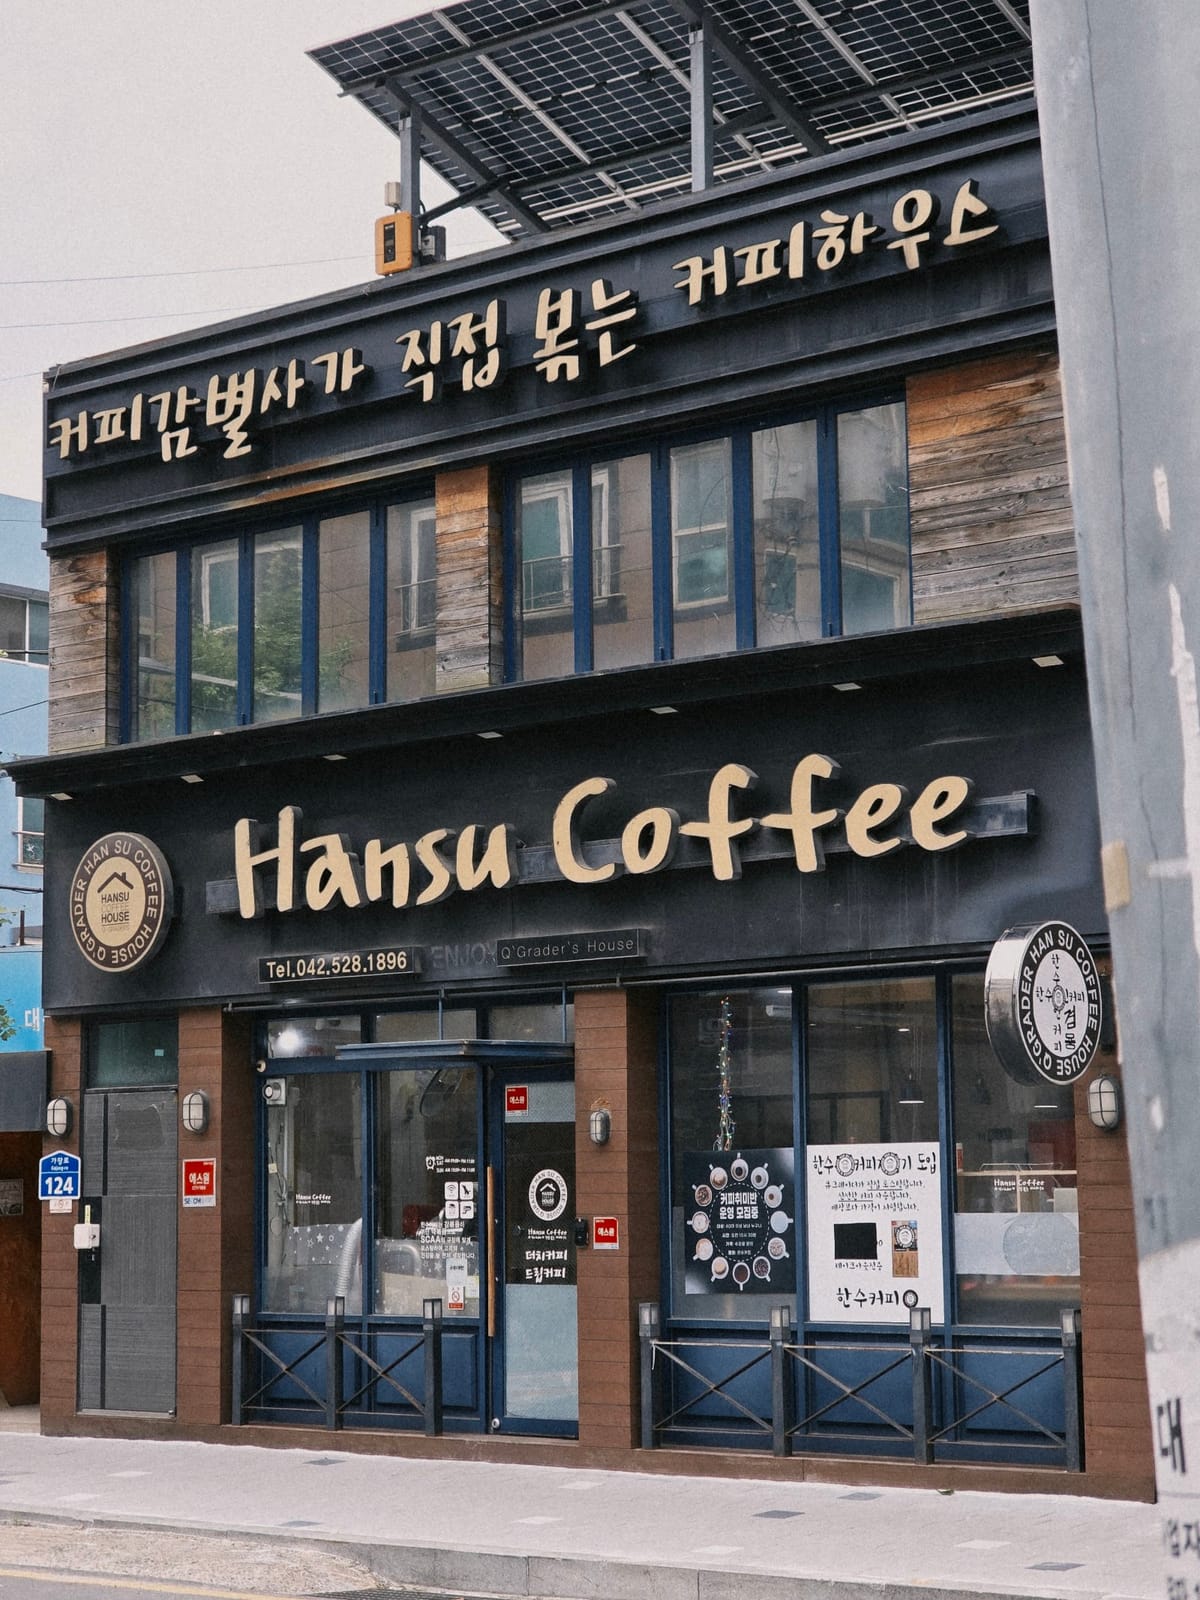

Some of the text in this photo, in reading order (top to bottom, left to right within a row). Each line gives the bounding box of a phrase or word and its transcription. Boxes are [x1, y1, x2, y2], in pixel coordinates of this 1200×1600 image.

[49, 178, 999, 462] 커피감별사가 직접 볶는 커피하우스
[235, 753, 970, 919] Hansu Coffee
[114, 839, 132, 855] SU
[84, 843, 109, 875] HAN
[134, 850, 159, 919] COFFEE
[101, 891, 130, 904] HANSU
[101, 911, 130, 923] HOUSE
[111, 924, 153, 964] HOUSE
[586, 938, 634, 953] House
[266, 950, 408, 980] Tel.042.528.1896
[1029, 929, 1098, 1076] HAN SU COFFEE HOUSE
[917, 1151, 936, 1175] 도입
[45, 1176, 74, 1195] 124
[188, 1172, 210, 1185] 에스원
[720, 1192, 758, 1205] 커피취미반
[719, 1205, 759, 1220] 운영 모집중
[525, 1249, 568, 1261] 더치커피
[525, 1266, 566, 1284] 드립커피
[836, 1287, 900, 1308] 한수커피
